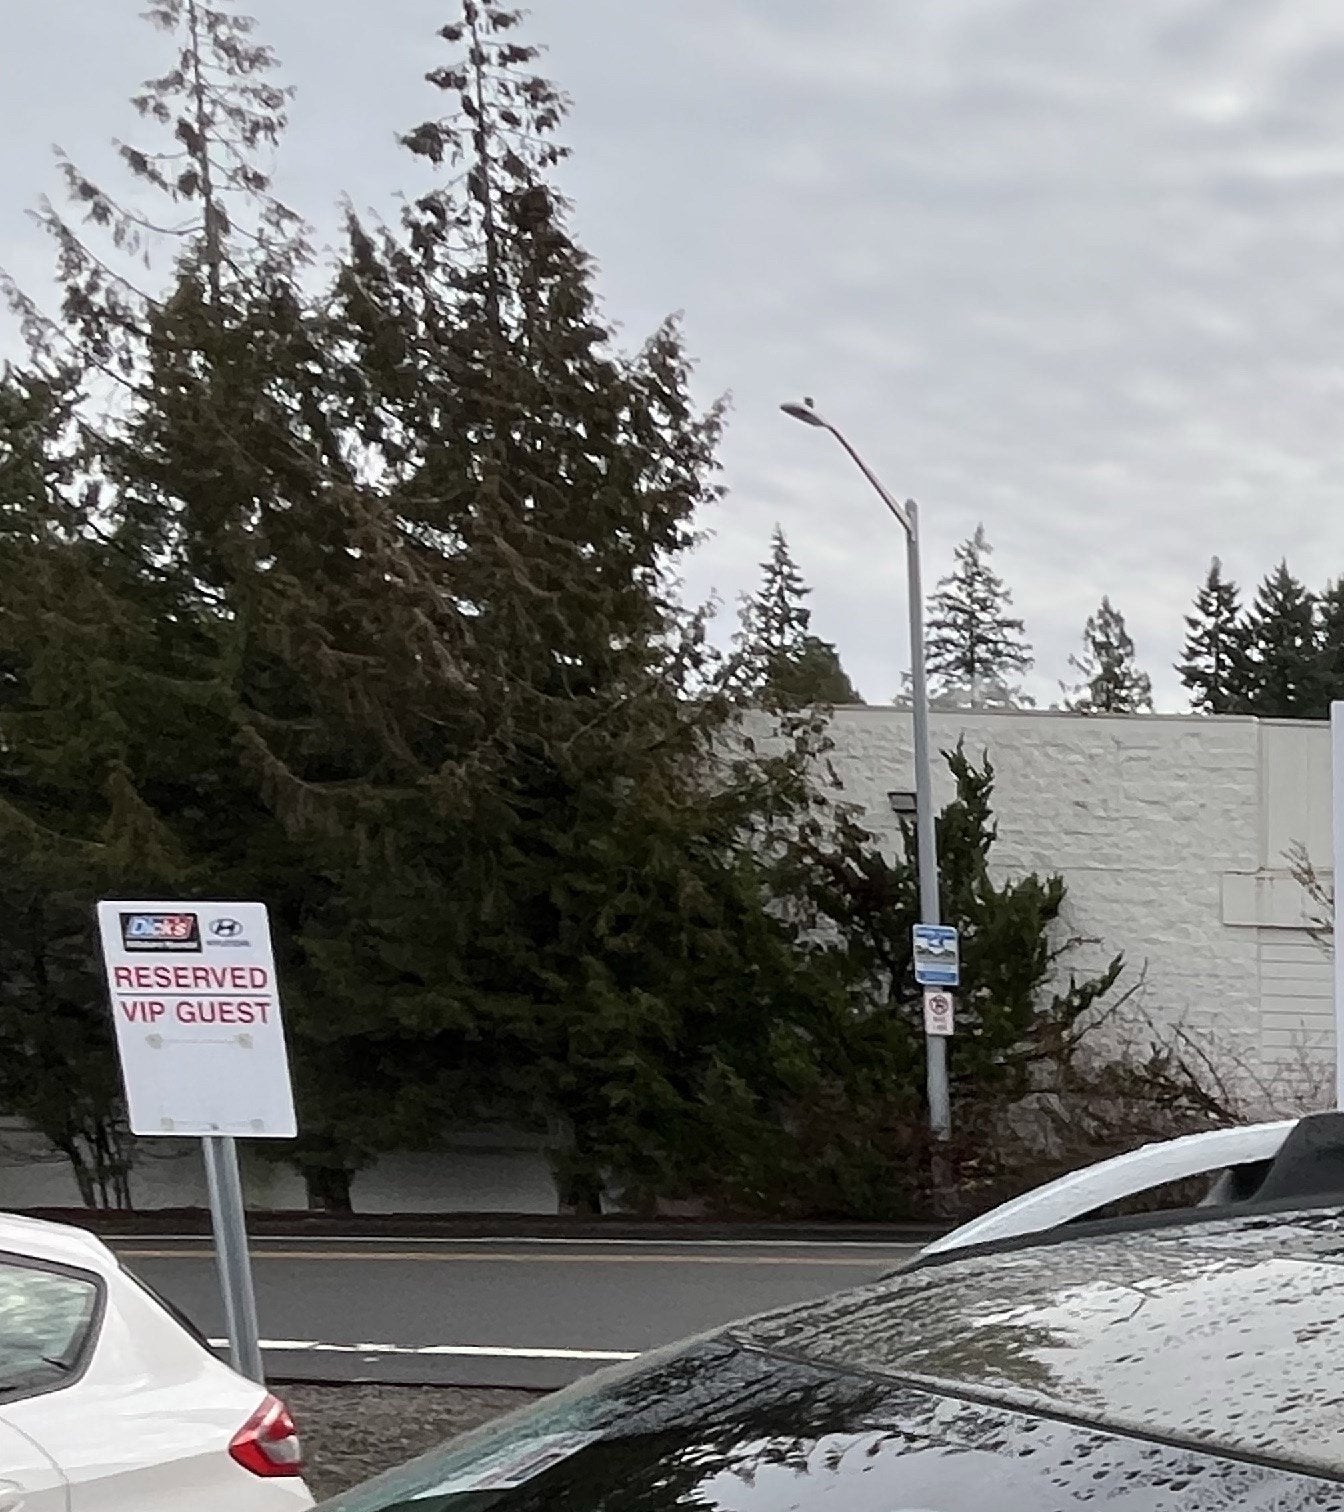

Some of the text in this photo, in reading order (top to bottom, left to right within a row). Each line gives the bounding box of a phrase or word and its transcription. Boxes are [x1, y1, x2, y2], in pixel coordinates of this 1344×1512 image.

[114, 966, 268, 989] RESERVED
[120, 1000, 271, 1024] VIP GUEST
